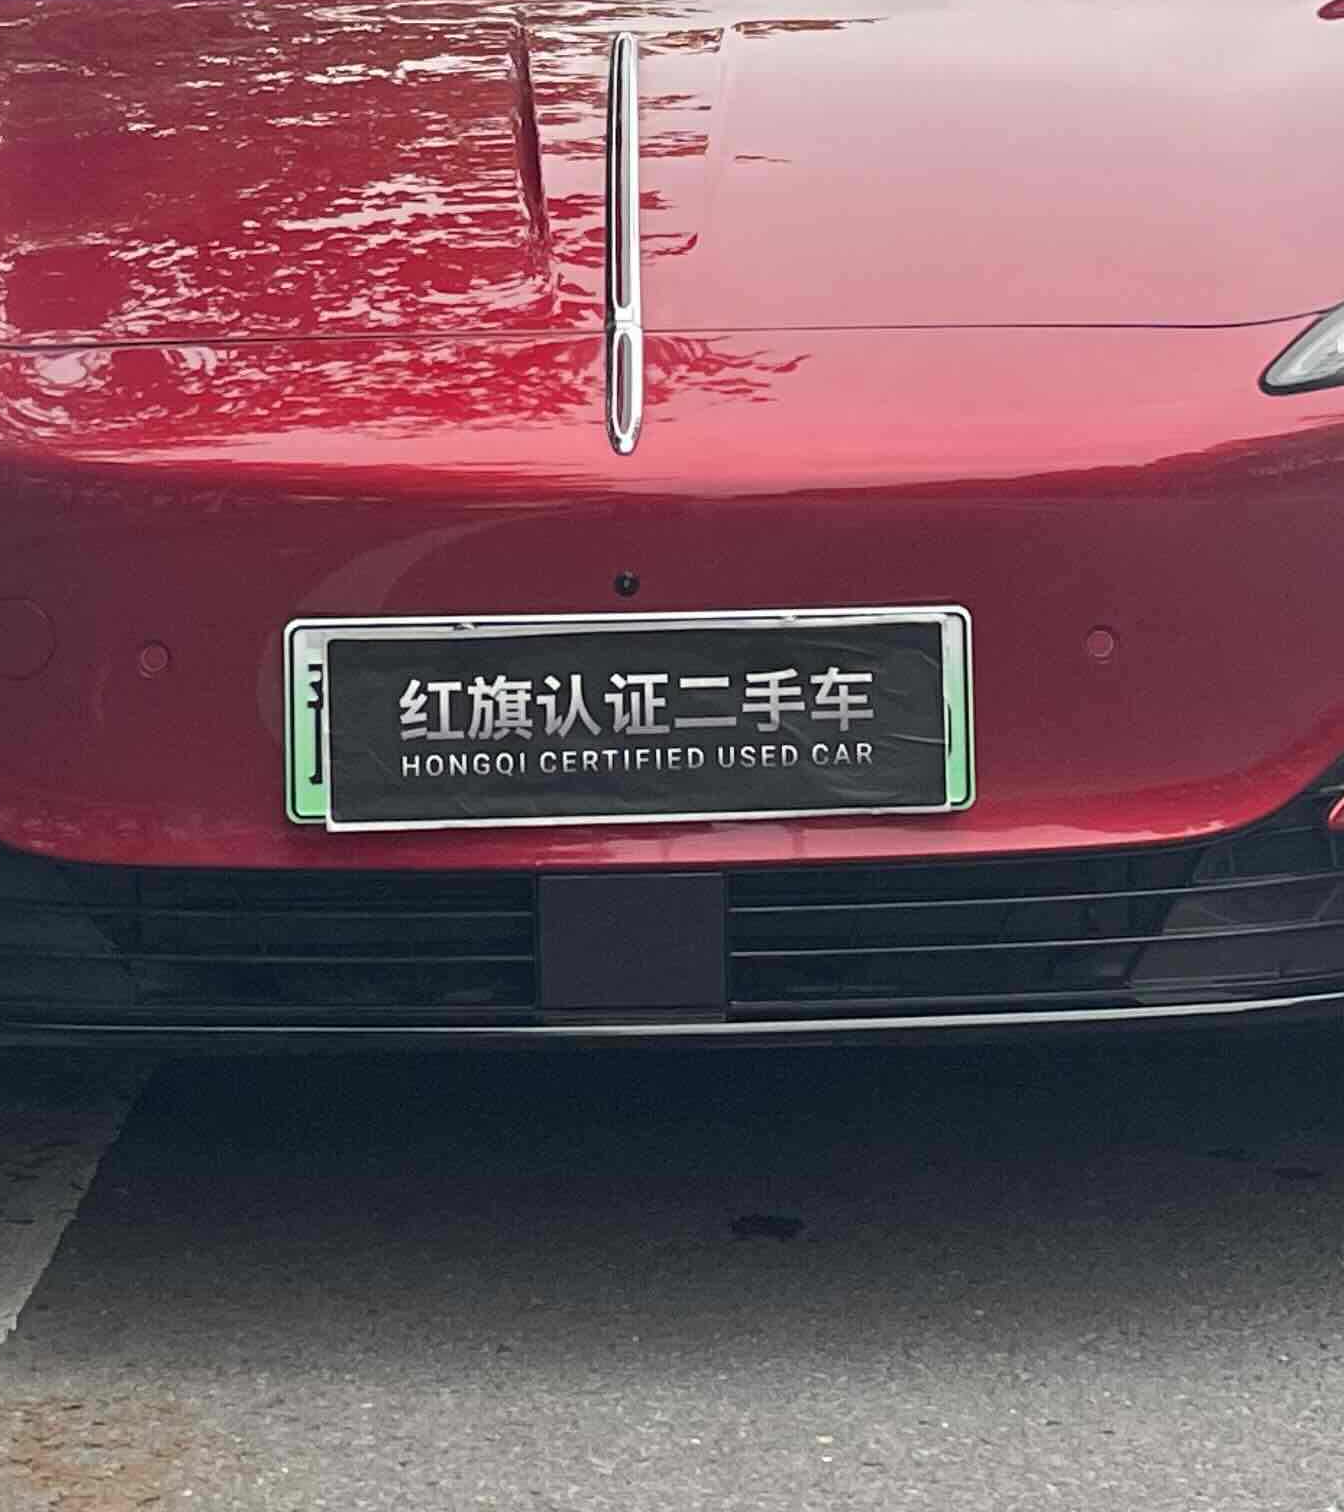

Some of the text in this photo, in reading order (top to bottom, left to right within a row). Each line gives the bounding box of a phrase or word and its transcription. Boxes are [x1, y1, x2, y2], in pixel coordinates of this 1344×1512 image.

[399, 666, 874, 741] 红旗认证二手车
[402, 742, 874, 777] HONGQI CERTIFIED USED CAR
